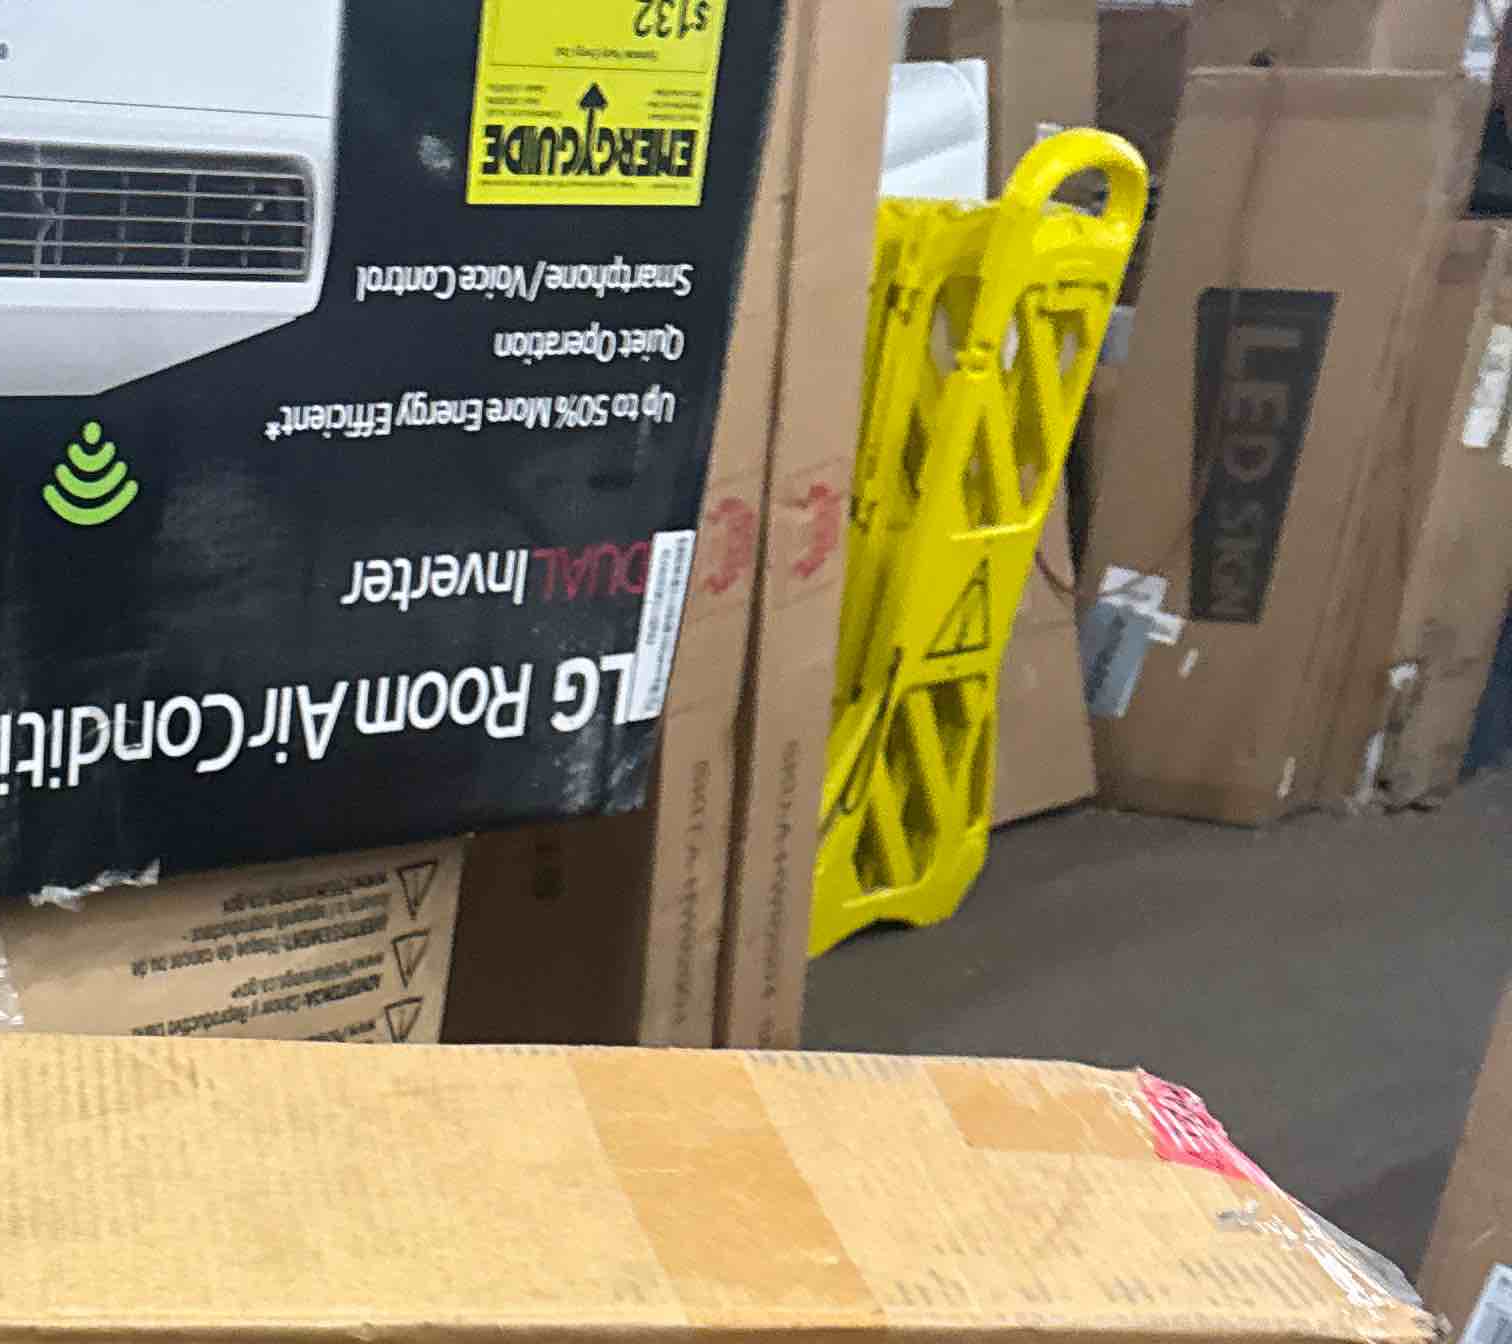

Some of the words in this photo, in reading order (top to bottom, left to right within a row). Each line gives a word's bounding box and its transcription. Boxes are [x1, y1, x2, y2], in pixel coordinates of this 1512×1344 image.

[356, 263, 456, 300] Control
[494, 320, 617, 365] Operation
[618, 323, 685, 362] Quiet
[395, 391, 483, 432] Energy
[486, 396, 552, 429] More
[554, 394, 610, 429] 50%
[611, 392, 639, 421] to
[641, 384, 676, 423] Up
[1223, 322, 1302, 484] LED
[341, 547, 528, 611] Inverter
[533, 540, 651, 596] DUAL
[354, 662, 532, 738] Room
[551, 651, 634, 733] LG
[248, 678, 348, 766] Air
